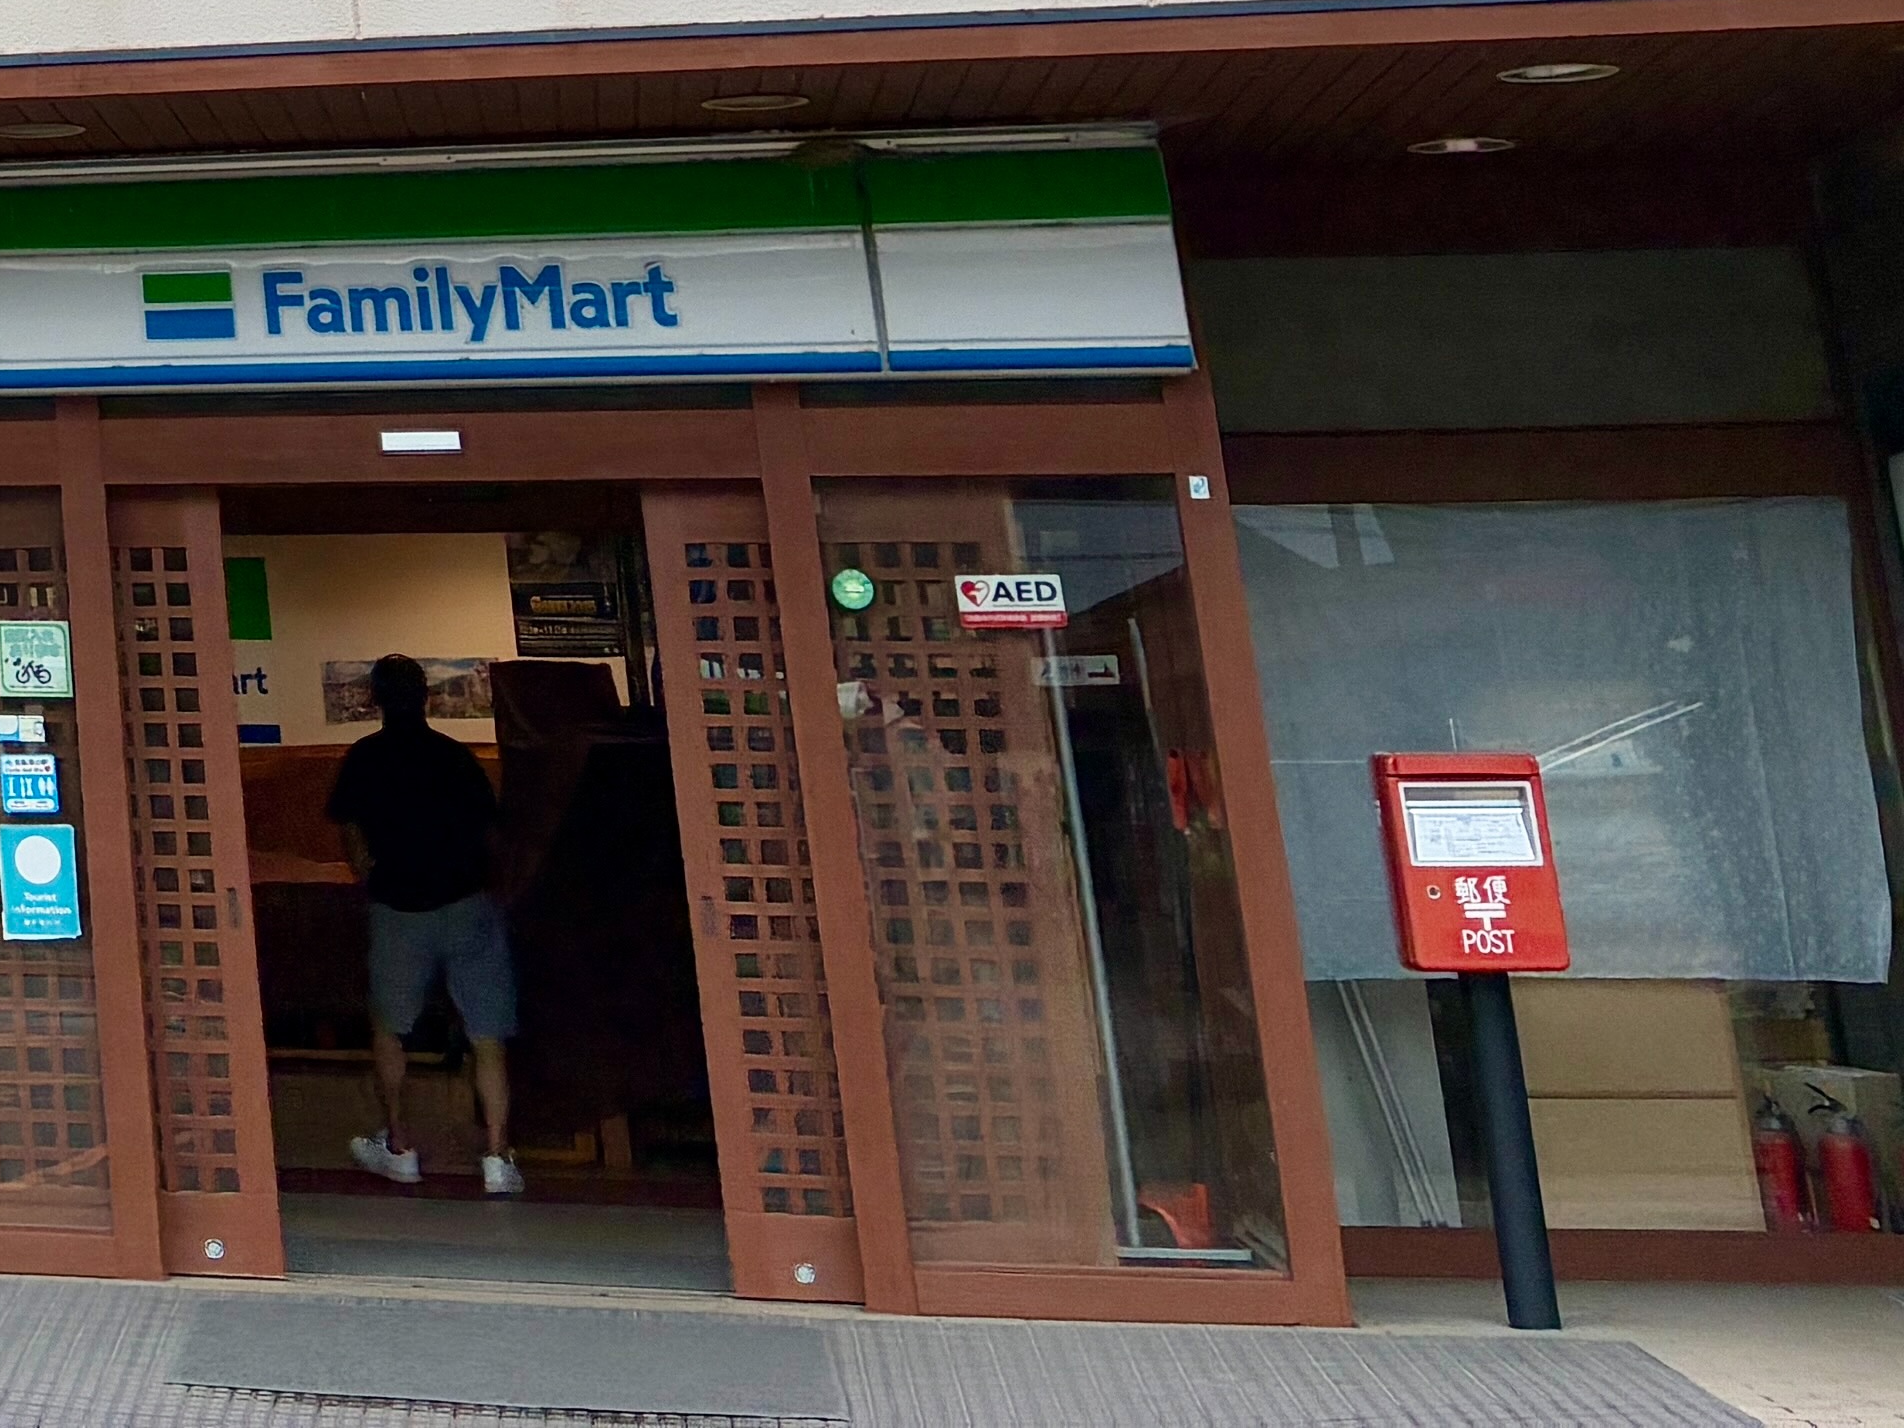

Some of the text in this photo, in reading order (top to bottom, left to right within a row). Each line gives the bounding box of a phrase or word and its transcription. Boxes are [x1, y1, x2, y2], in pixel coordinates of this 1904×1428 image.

[262, 256, 681, 342] FamilyMart
[992, 581, 1058, 602] AED
[1454, 875, 1511, 905] 郵便
[1461, 929, 1515, 954] POST
